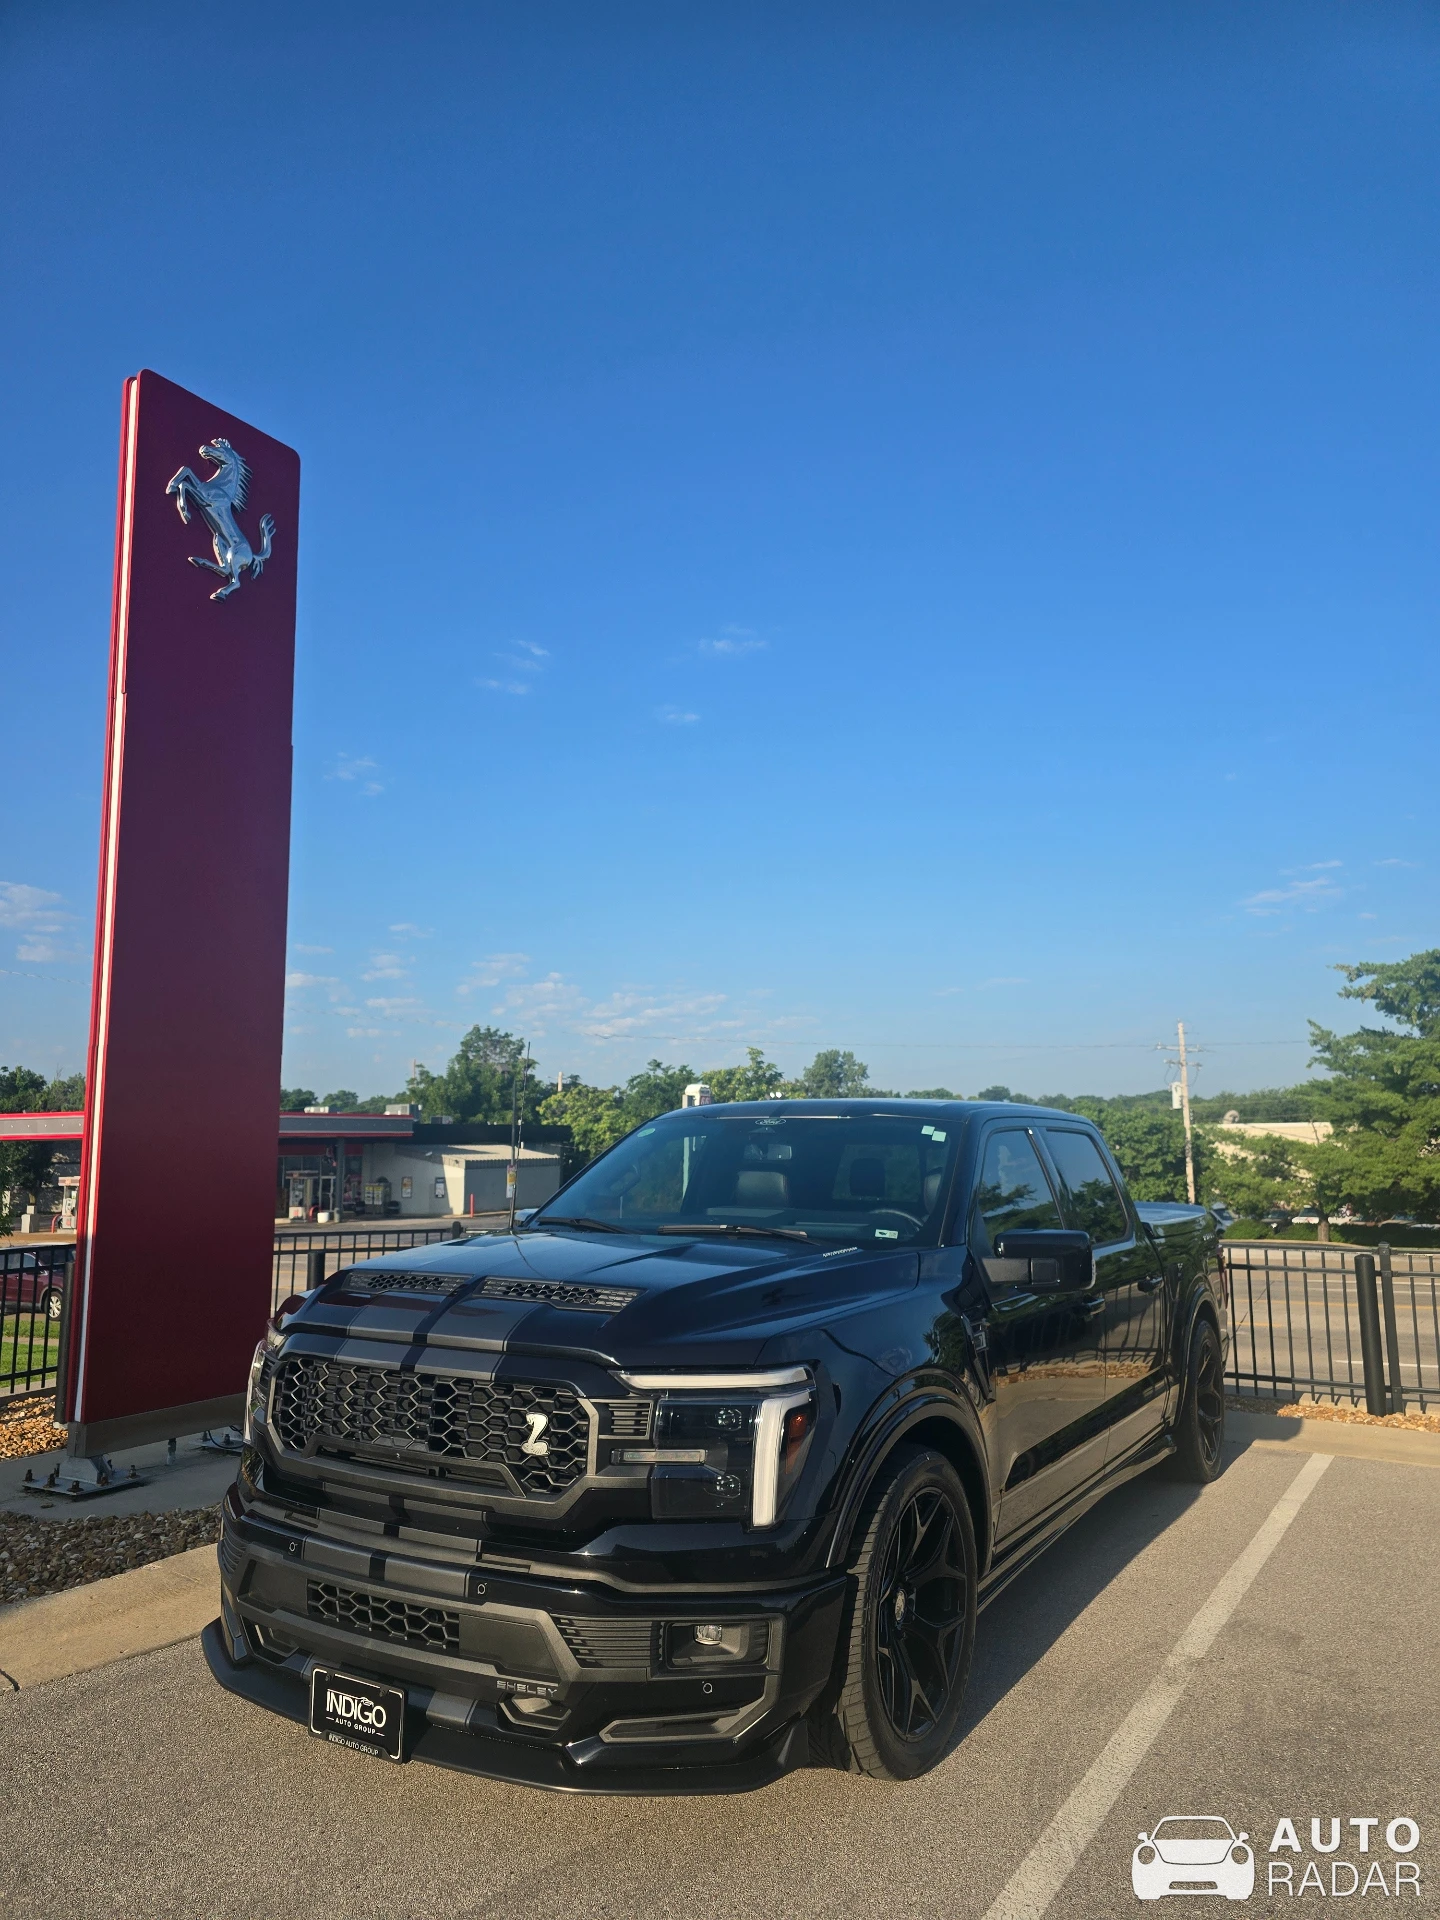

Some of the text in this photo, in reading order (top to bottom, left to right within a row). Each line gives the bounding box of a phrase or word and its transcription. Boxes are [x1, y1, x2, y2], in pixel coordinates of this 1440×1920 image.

[496, 1680, 557, 1697] SHELBY
[326, 1689, 387, 1728] INDIGO
[335, 1717, 376, 1735] AUTO GROUP
[328, 1732, 379, 1756] INDIGO AUTO GROUP
